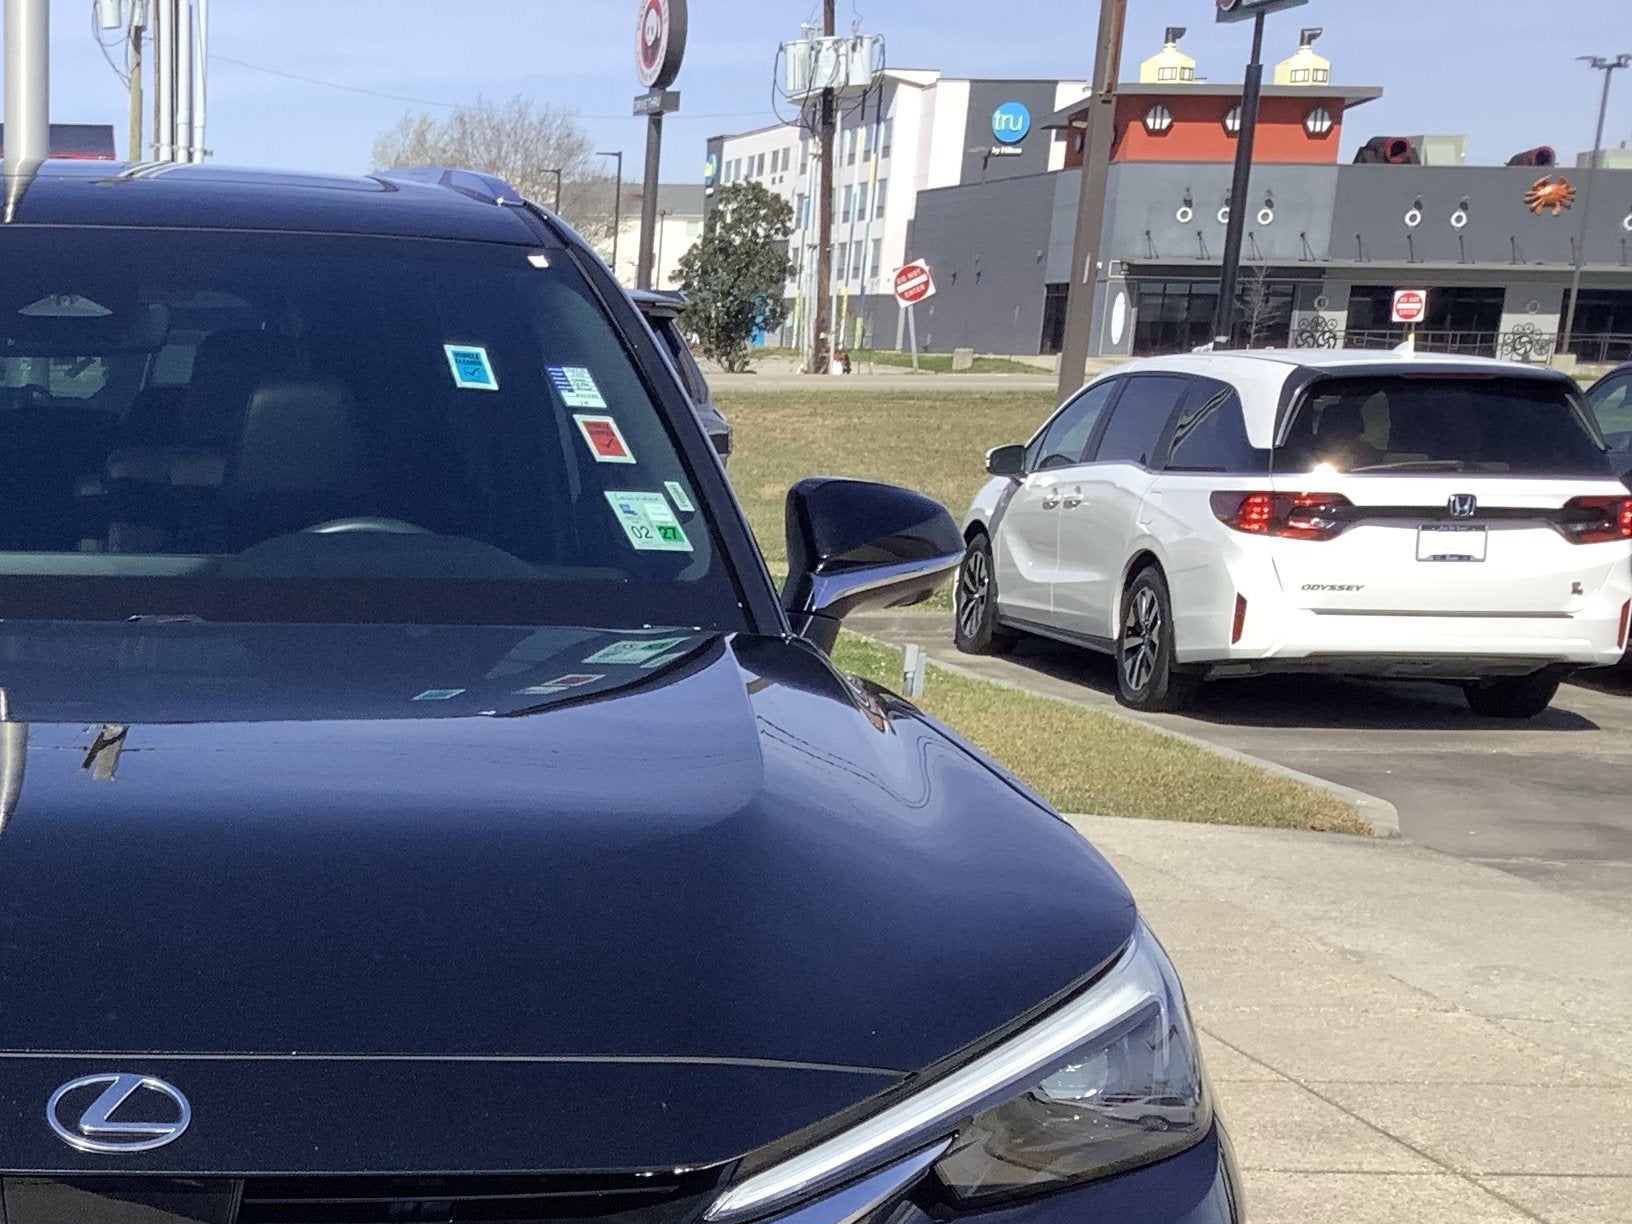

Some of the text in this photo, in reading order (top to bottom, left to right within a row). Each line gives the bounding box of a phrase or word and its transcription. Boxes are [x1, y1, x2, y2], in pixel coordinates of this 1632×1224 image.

[993, 110, 1023, 131] tru
[897, 268, 921, 285] DO NOT
[904, 284, 925, 298] ENTER
[631, 526, 677, 540] 02 27
